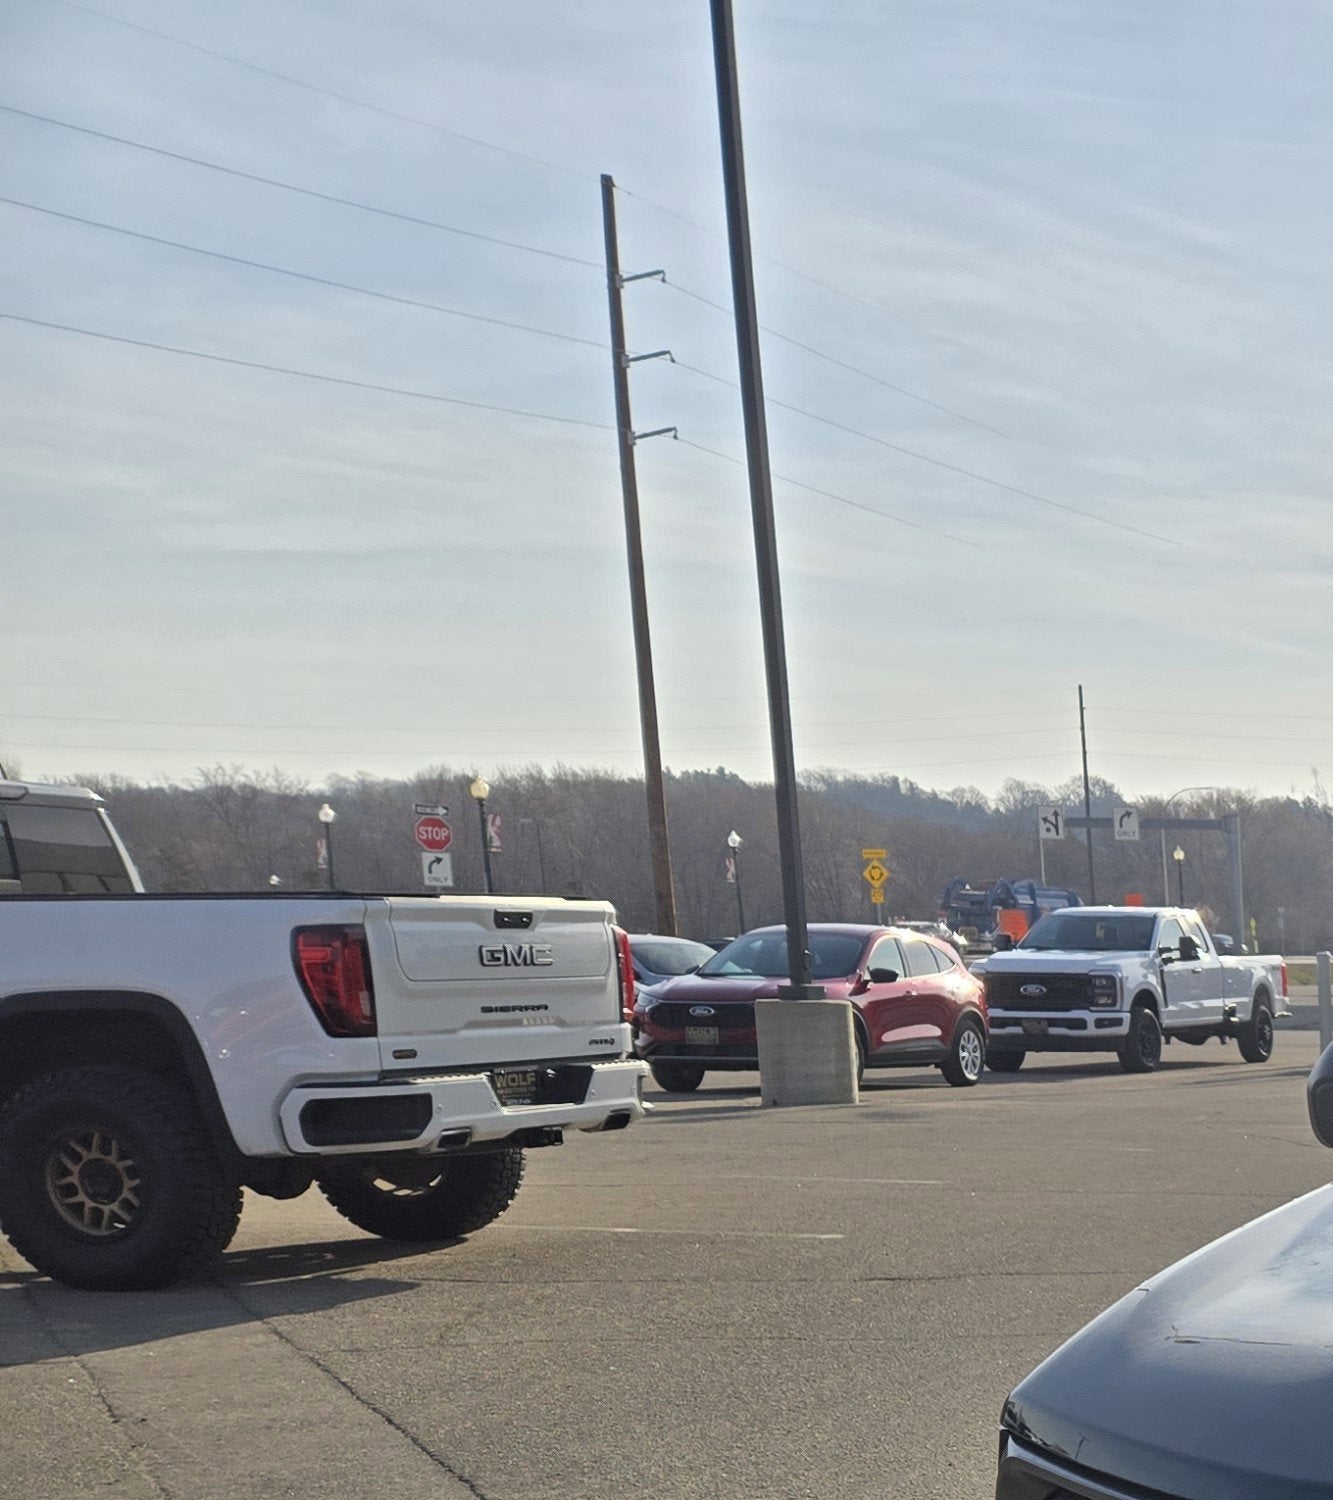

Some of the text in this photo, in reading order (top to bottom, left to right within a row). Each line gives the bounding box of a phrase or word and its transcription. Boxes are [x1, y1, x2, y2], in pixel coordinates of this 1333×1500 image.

[418, 826, 449, 841] STOP
[479, 943, 554, 967] GMC
[480, 1004, 549, 1014] SIERRA
[495, 1072, 537, 1088] WOLF
